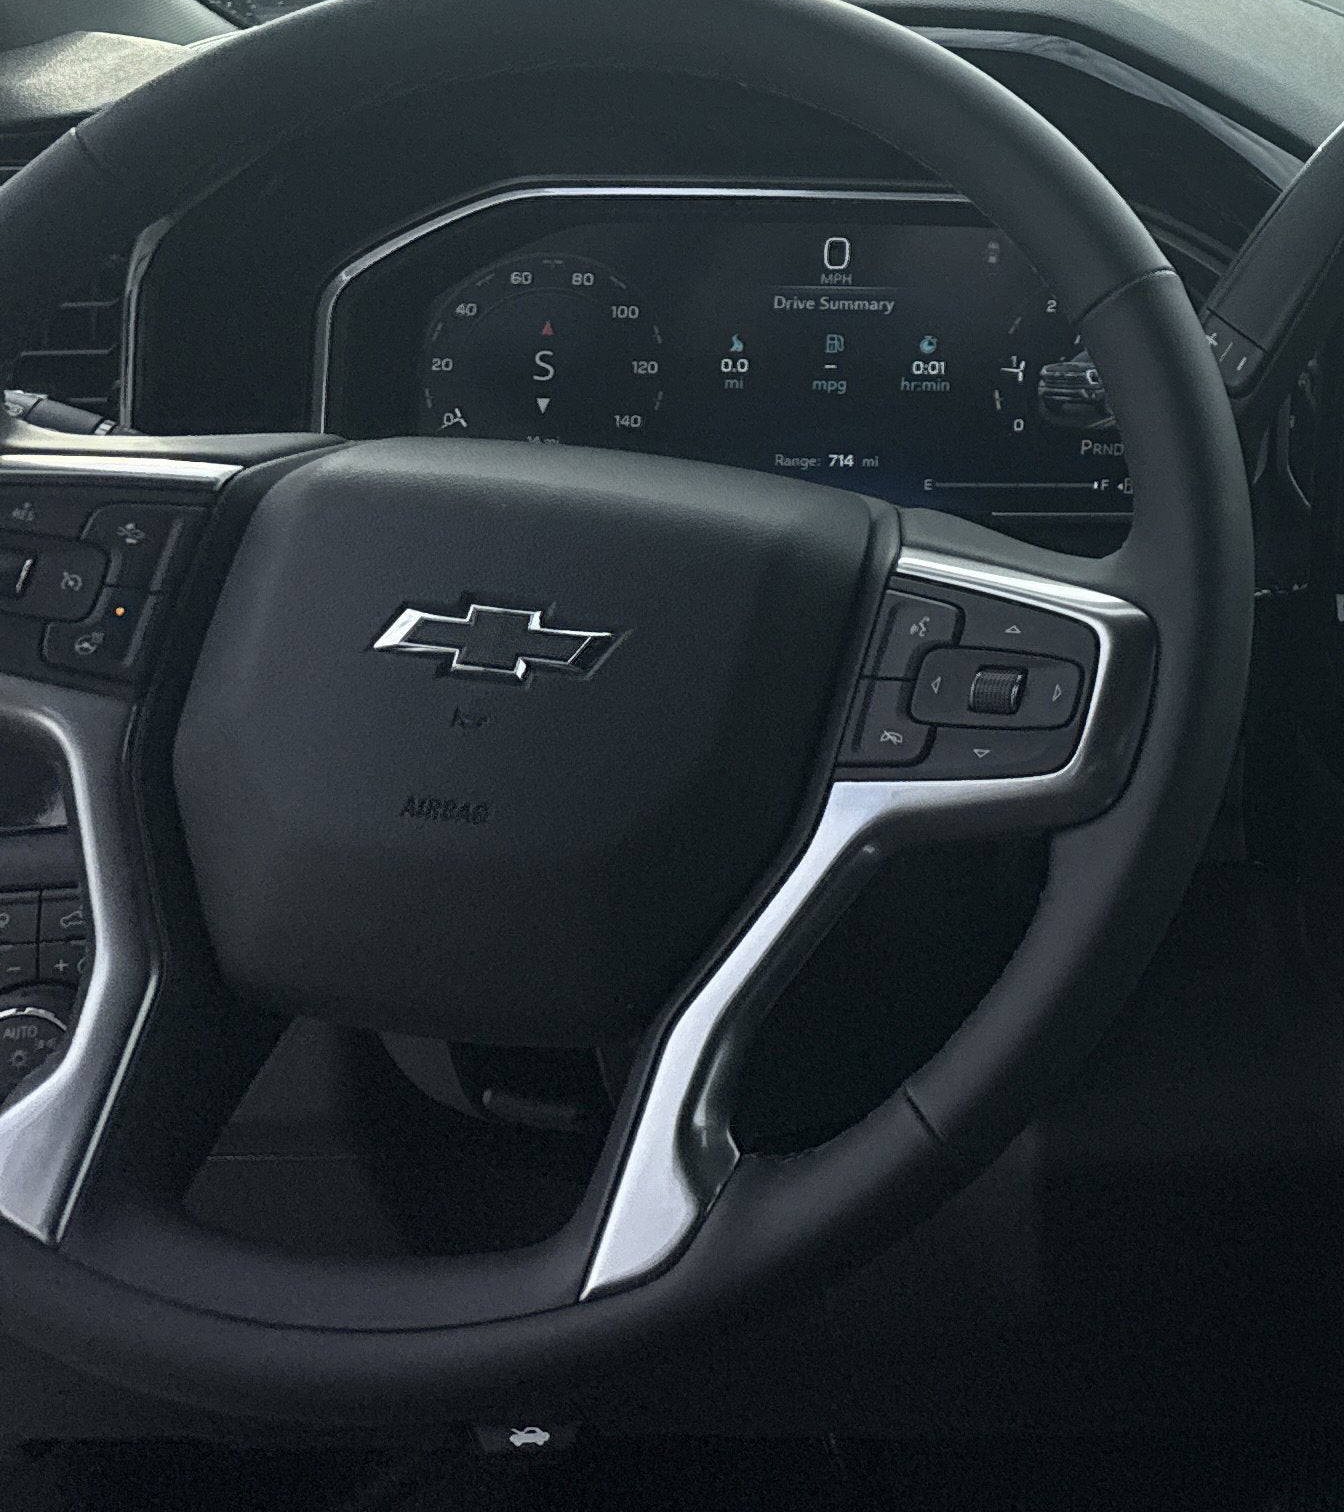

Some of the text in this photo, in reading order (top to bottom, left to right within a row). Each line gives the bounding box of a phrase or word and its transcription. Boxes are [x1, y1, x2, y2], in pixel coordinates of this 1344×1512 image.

[823, 237, 850, 270] 0
[510, 271, 532, 285] 60
[572, 272, 594, 286] 80
[820, 273, 852, 285] MPH
[456, 303, 477, 317] 40
[773, 295, 895, 315] Drive Summary
[1046, 299, 1057, 313] 2
[611, 306, 639, 319] 100
[431, 358, 453, 371] 20
[533, 350, 555, 381] S
[632, 361, 658, 374] 120
[720, 358, 750, 373] 0.0
[912, 360, 946, 375] 0:01
[724, 377, 744, 389] mi
[812, 379, 847, 394] mpg
[900, 377, 950, 392] hr:min
[614, 414, 641, 428] 140
[1014, 419, 1024, 431] 0
[774, 454, 879, 470] Range: 714 mi
[923, 478, 933, 491] E
[1100, 479, 1110, 491] F
[400, 795, 488, 825] AIRBAG
[3, 1026, 38, 1040] AUTO
